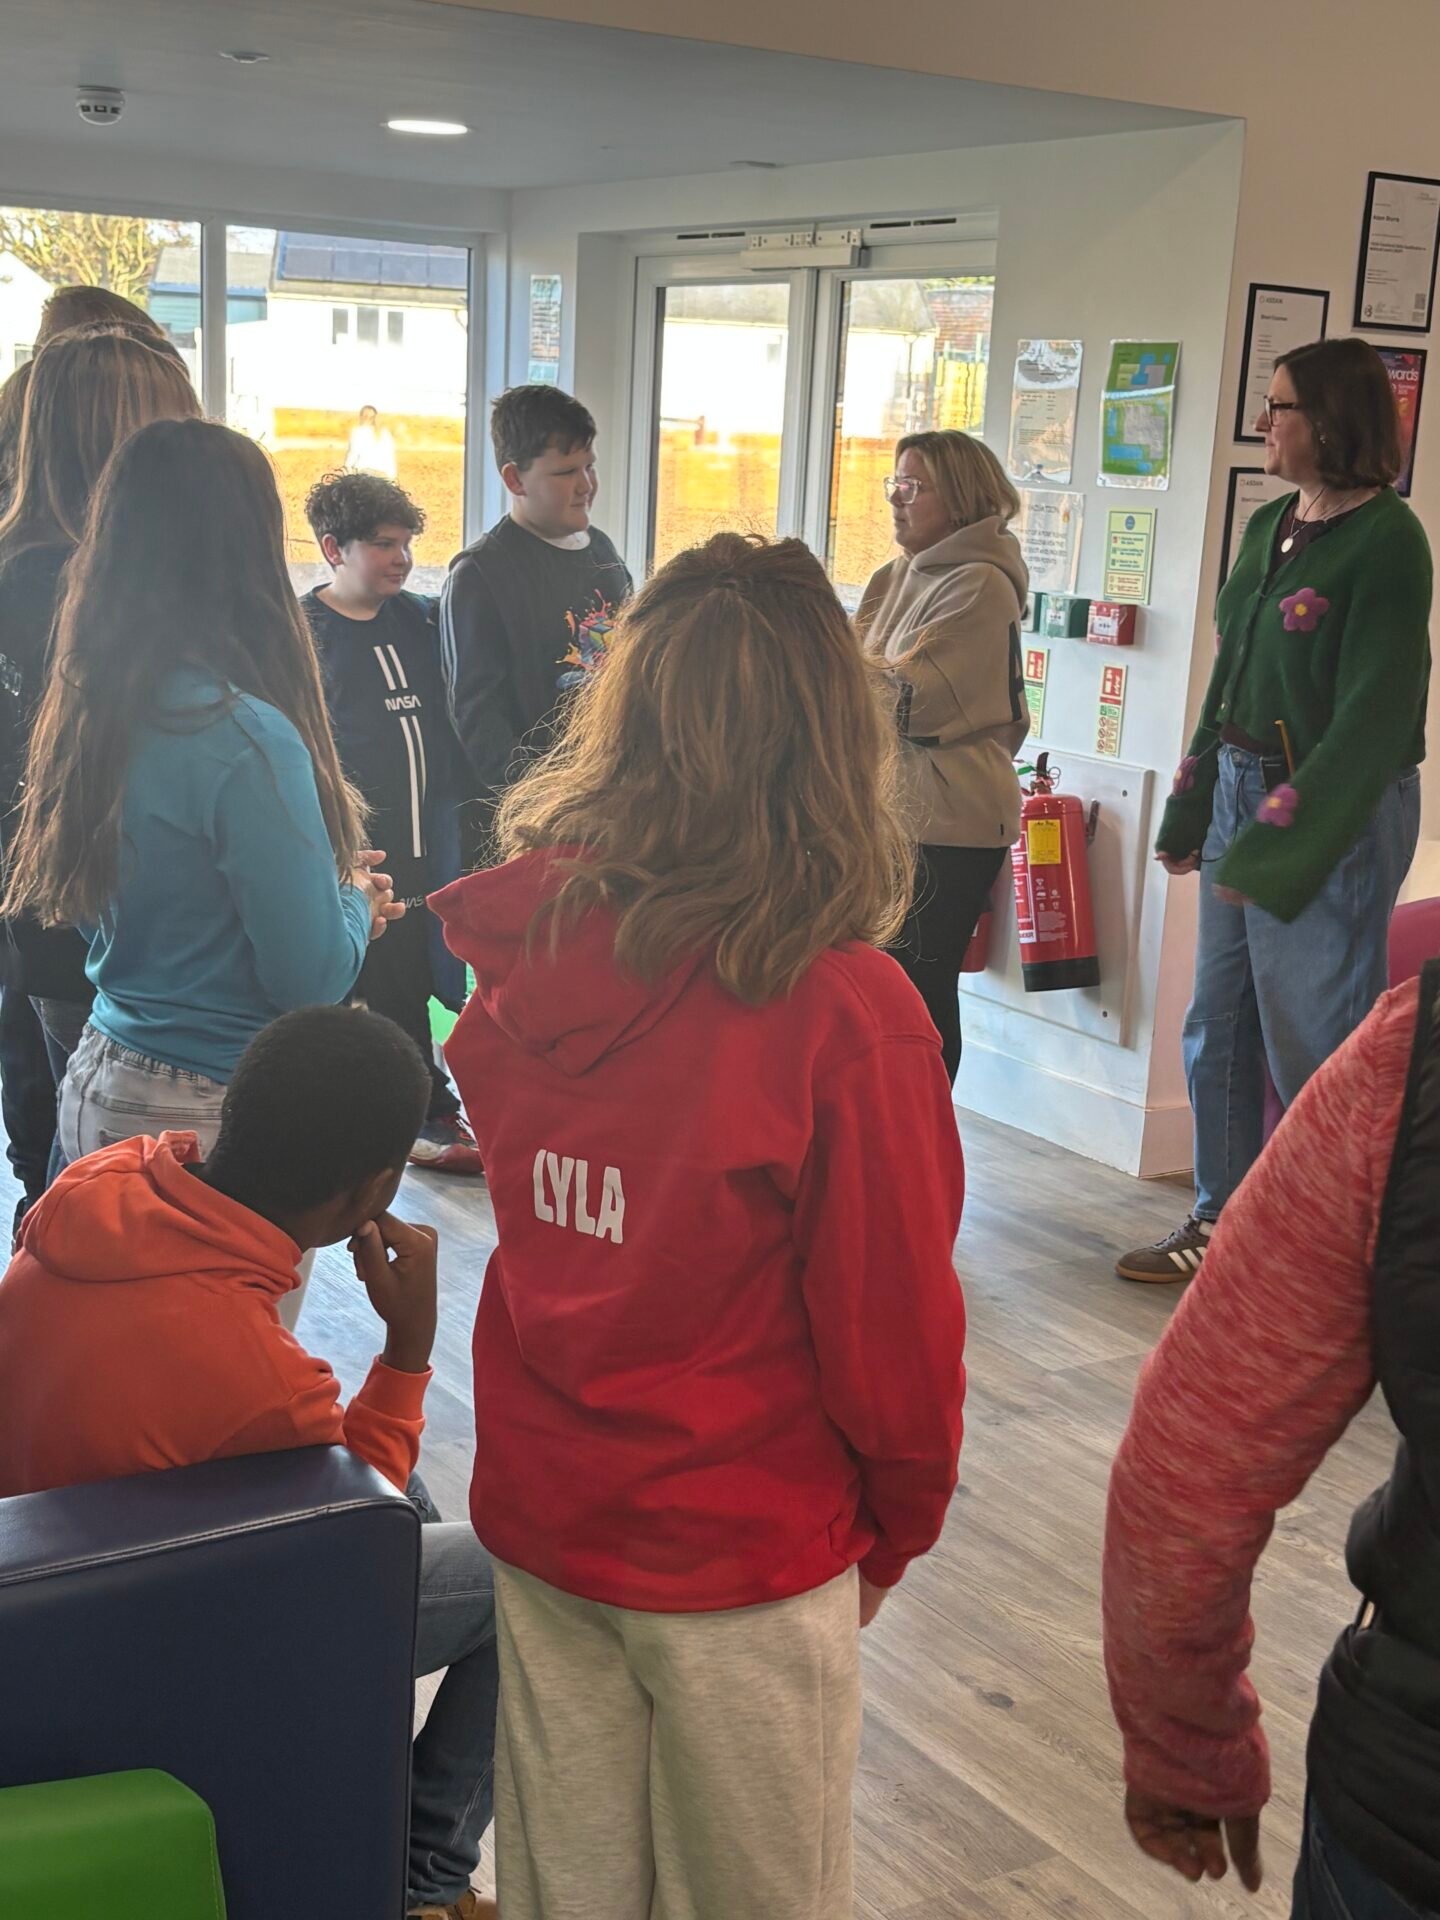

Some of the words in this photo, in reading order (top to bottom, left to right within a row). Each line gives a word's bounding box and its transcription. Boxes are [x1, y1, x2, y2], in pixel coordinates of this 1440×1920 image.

[1387, 368, 1419, 381] wards
[385, 695, 422, 711] NASA
[533, 1149, 625, 1244] LYLA
